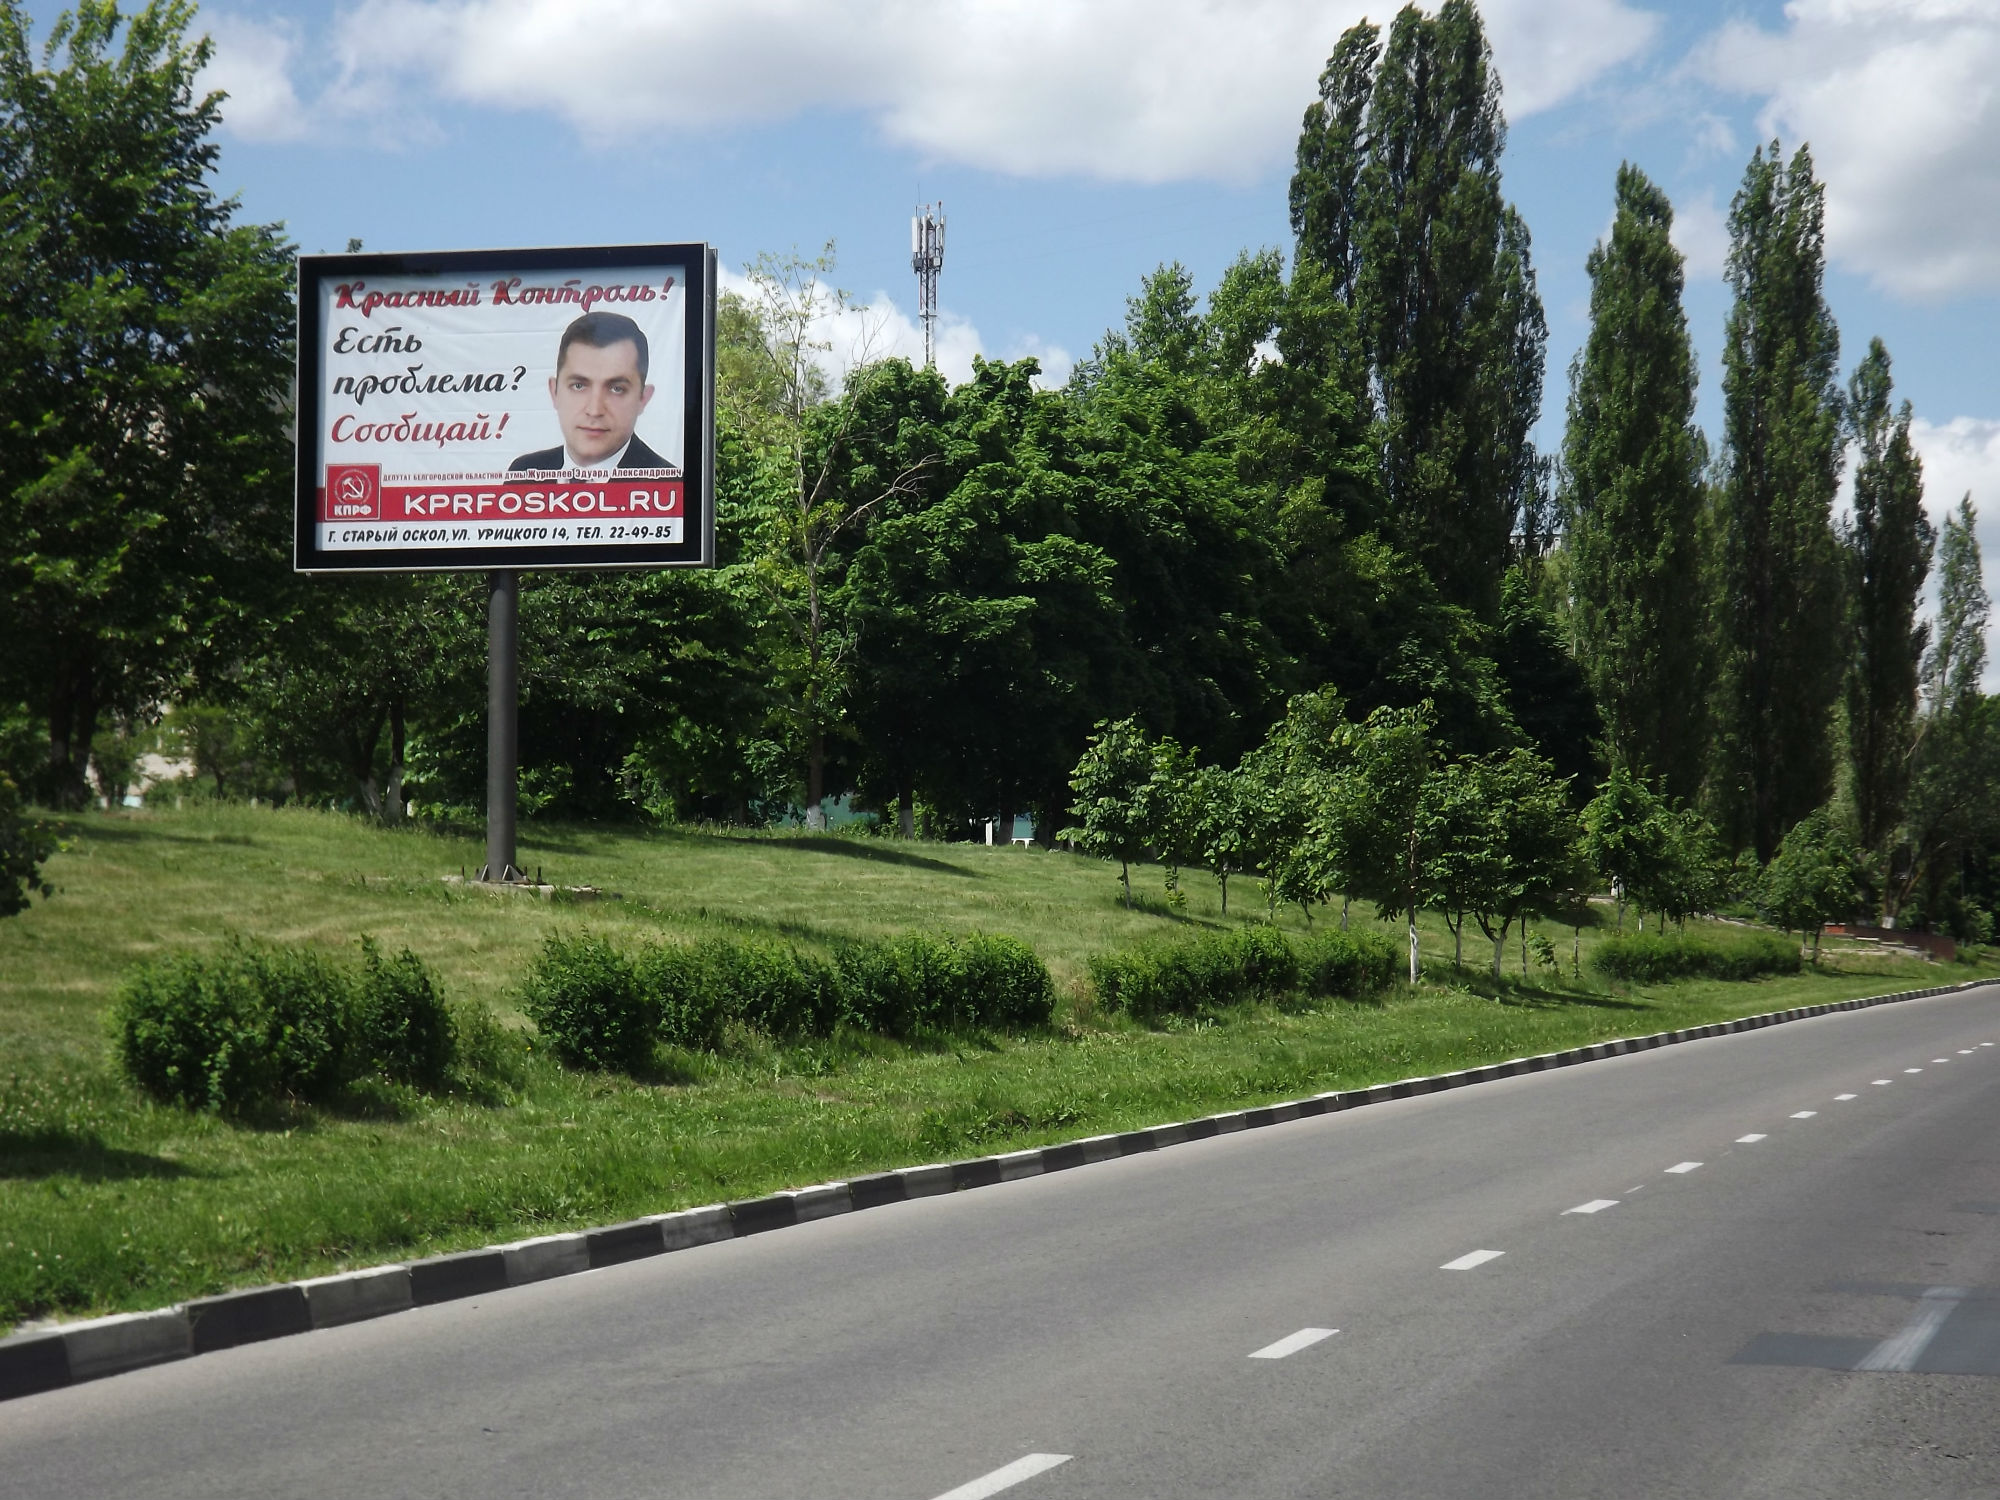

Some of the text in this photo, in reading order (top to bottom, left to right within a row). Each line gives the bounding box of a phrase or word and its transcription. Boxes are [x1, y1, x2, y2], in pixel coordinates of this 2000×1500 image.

[335, 277, 675, 318] Красный Контроль!
[333, 326, 422, 354] Есть
[333, 363, 527, 405] проблема?
[331, 412, 511, 448] Сообщай!
[383, 474, 411, 482] ДЕПУТАТ
[575, 468, 609, 479] Эдуард
[611, 467, 682, 478] Александрович
[334, 504, 372, 516] КПРФ
[404, 491, 676, 515] KPRFOSKOL.RU
[328, 530, 337, 543] Г.
[342, 527, 398, 543] СТАРЫЙ
[477, 527, 548, 541] УРИЦКОГО
[551, 527, 570, 541] 14,
[576, 526, 604, 540] ТЕЛ.
[609, 525, 672, 539] 22-49-85
